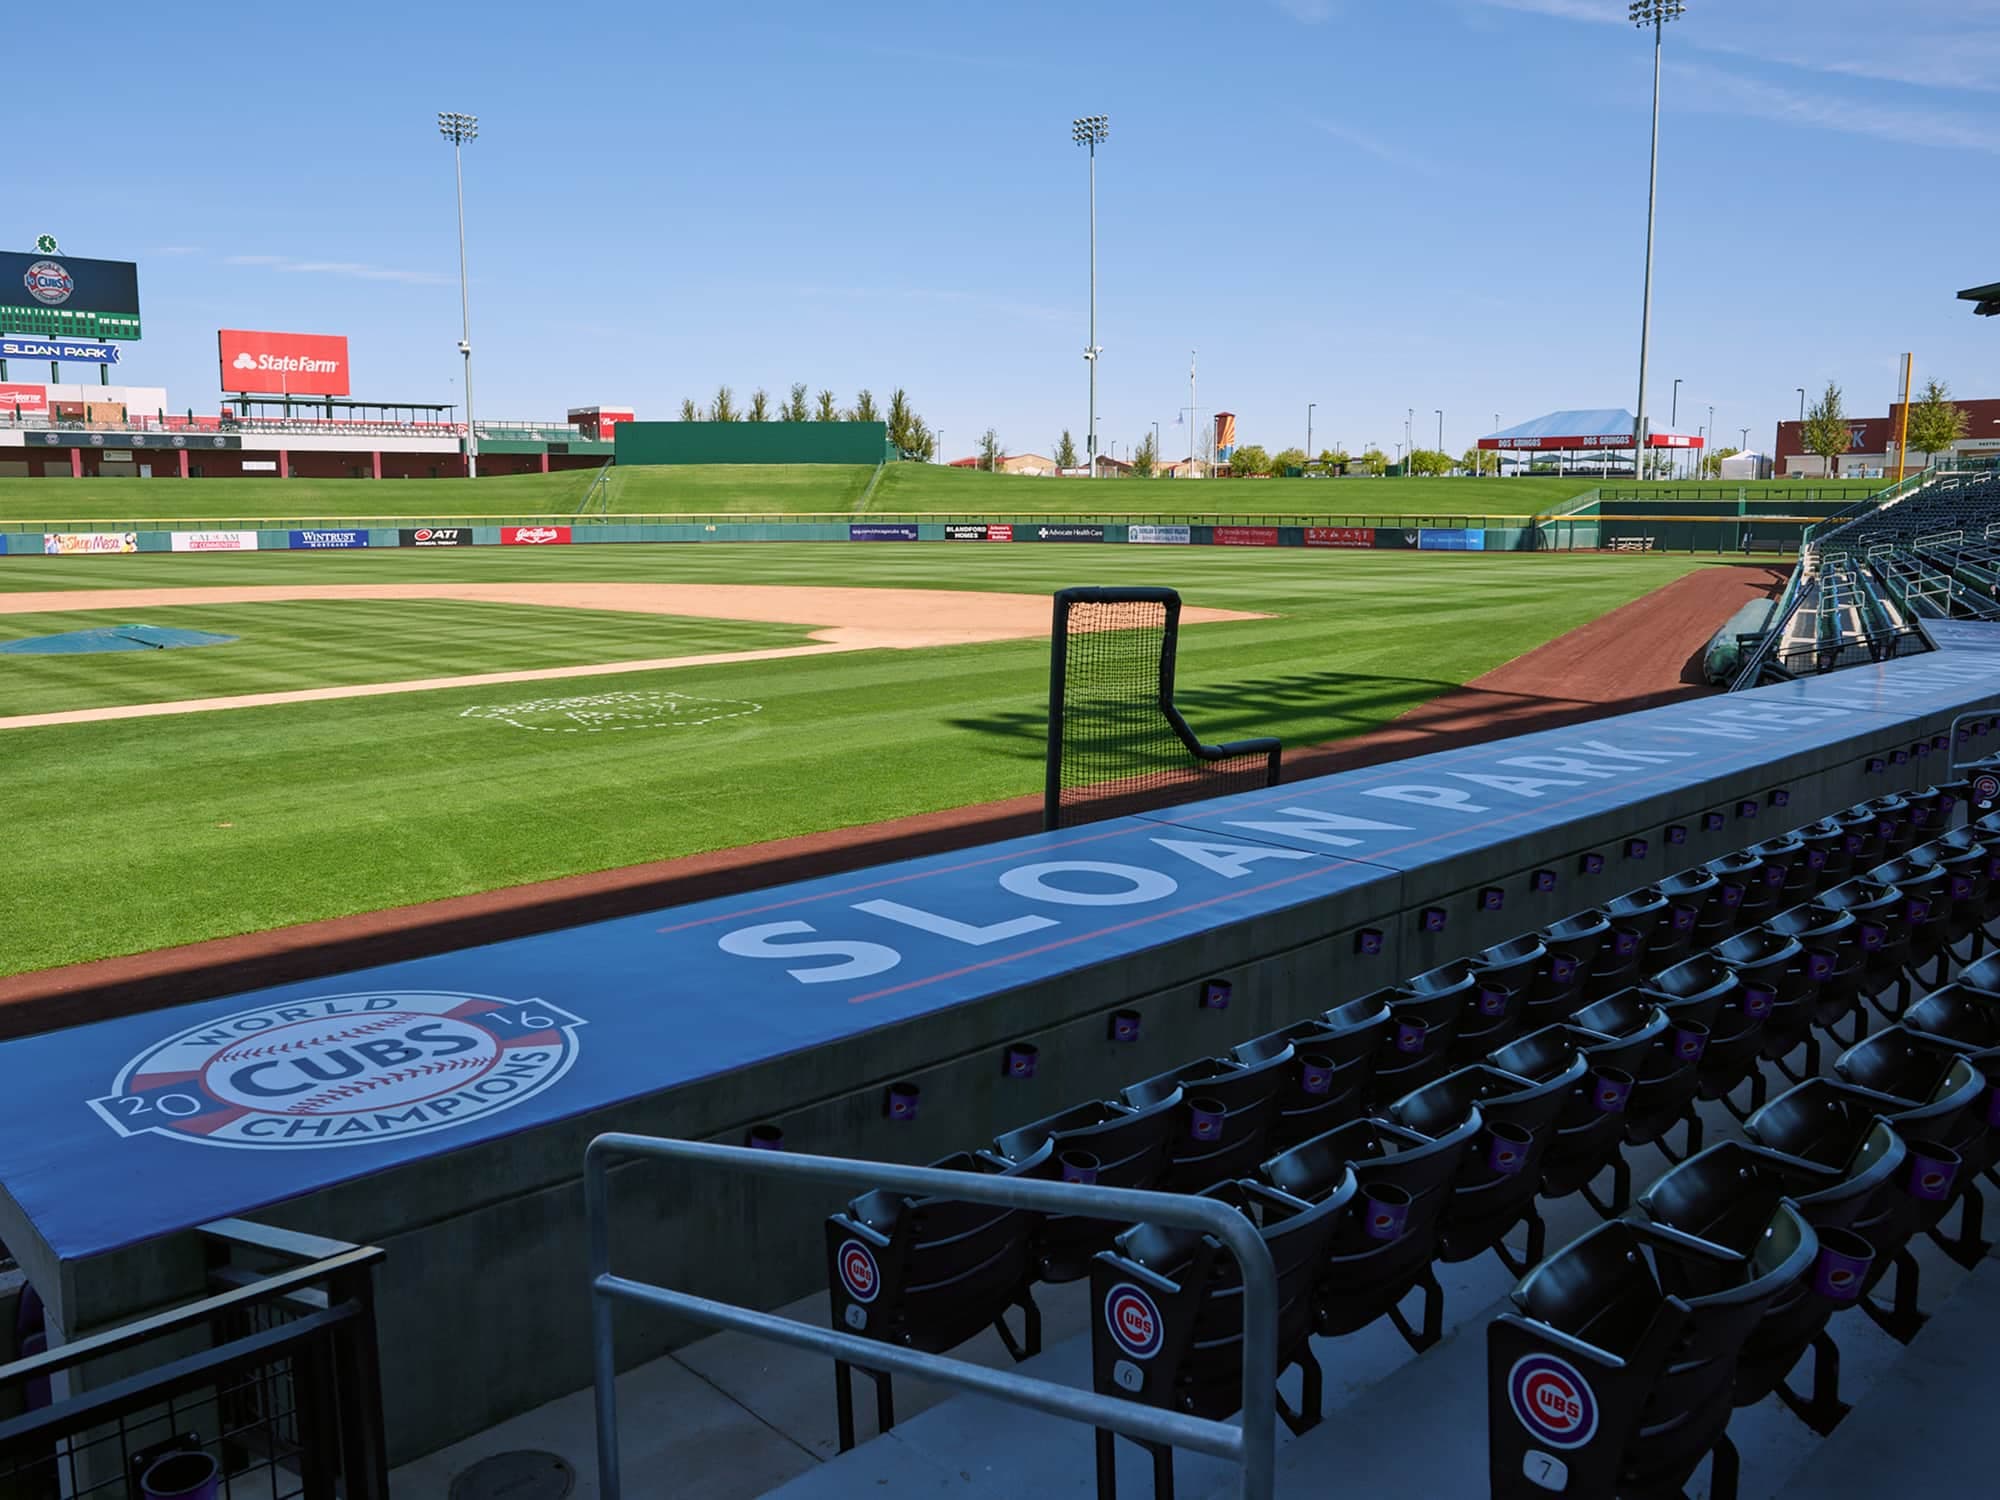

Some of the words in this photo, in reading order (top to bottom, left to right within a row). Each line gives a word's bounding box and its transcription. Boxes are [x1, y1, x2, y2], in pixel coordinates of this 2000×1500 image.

[38, 276, 64, 289] CUBS
[3, 343, 60, 356] SLOAN
[64, 346, 107, 358] PARK
[1498, 439, 1511, 447] DOS
[1583, 437, 1597, 445] DOS
[302, 531, 356, 541] WINTRUST
[432, 529, 458, 539] ATI
[66, 536, 91, 552] Shop
[93, 536, 120, 550] Mesa
[717, 806, 1417, 984] SLOAN
[1359, 740, 1699, 813] PARK
[1651, 697, 1889, 740] MESA
[181, 998, 398, 1046] WORLD
[229, 1023, 478, 1098] CUBS
[240, 1052, 551, 1138] CHAMPIONS
[1540, 1459, 1552, 1480] 7
